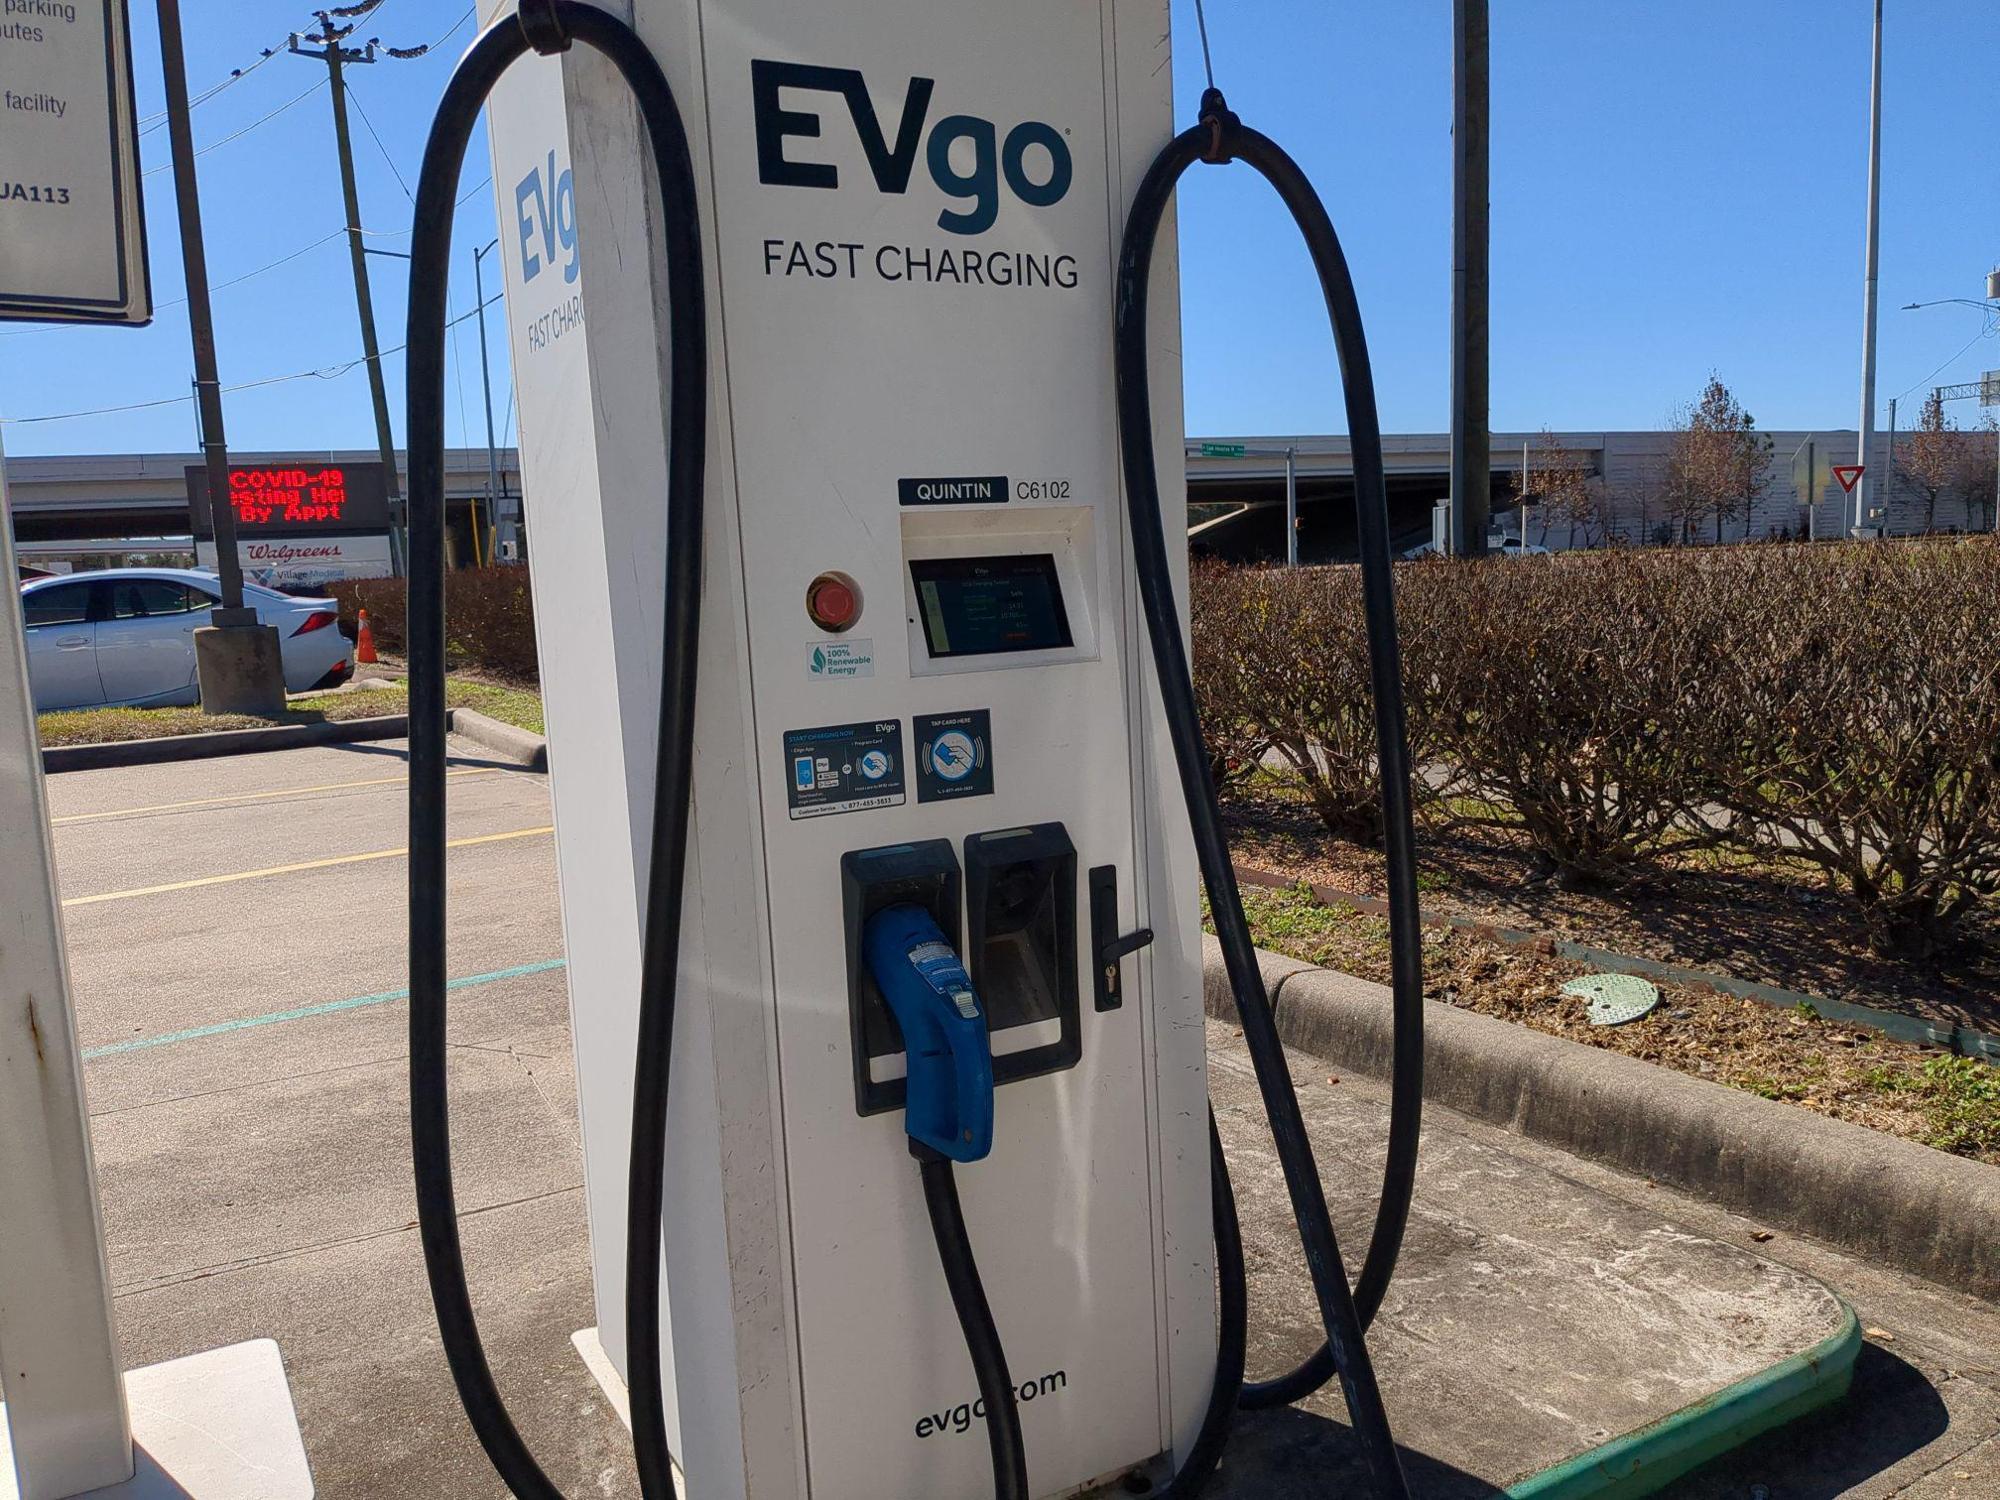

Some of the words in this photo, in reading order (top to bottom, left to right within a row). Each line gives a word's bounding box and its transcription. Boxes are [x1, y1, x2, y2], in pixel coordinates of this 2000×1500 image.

[5, 0, 75, 22] parking
[5, 90, 66, 117] facility
[751, 59, 1072, 235] EVgo
[515, 149, 580, 284] EVg
[763, 239, 864, 279] FAST
[875, 245, 1078, 289] CHARGING
[528, 315, 550, 353] FAST
[229, 469, 343, 488] COVID-19
[917, 483, 991, 500] QUINTIN
[1017, 481, 1070, 499] C6102
[239, 506, 272, 523] By
[247, 543, 342, 563] Walgreens
[827, 649, 850, 657] 100%
[827, 656, 871, 666] Renewable
[828, 666, 857, 675] Energy
[875, 724, 896, 733] EVgo
[915, 1370, 1067, 1438] evgoom
